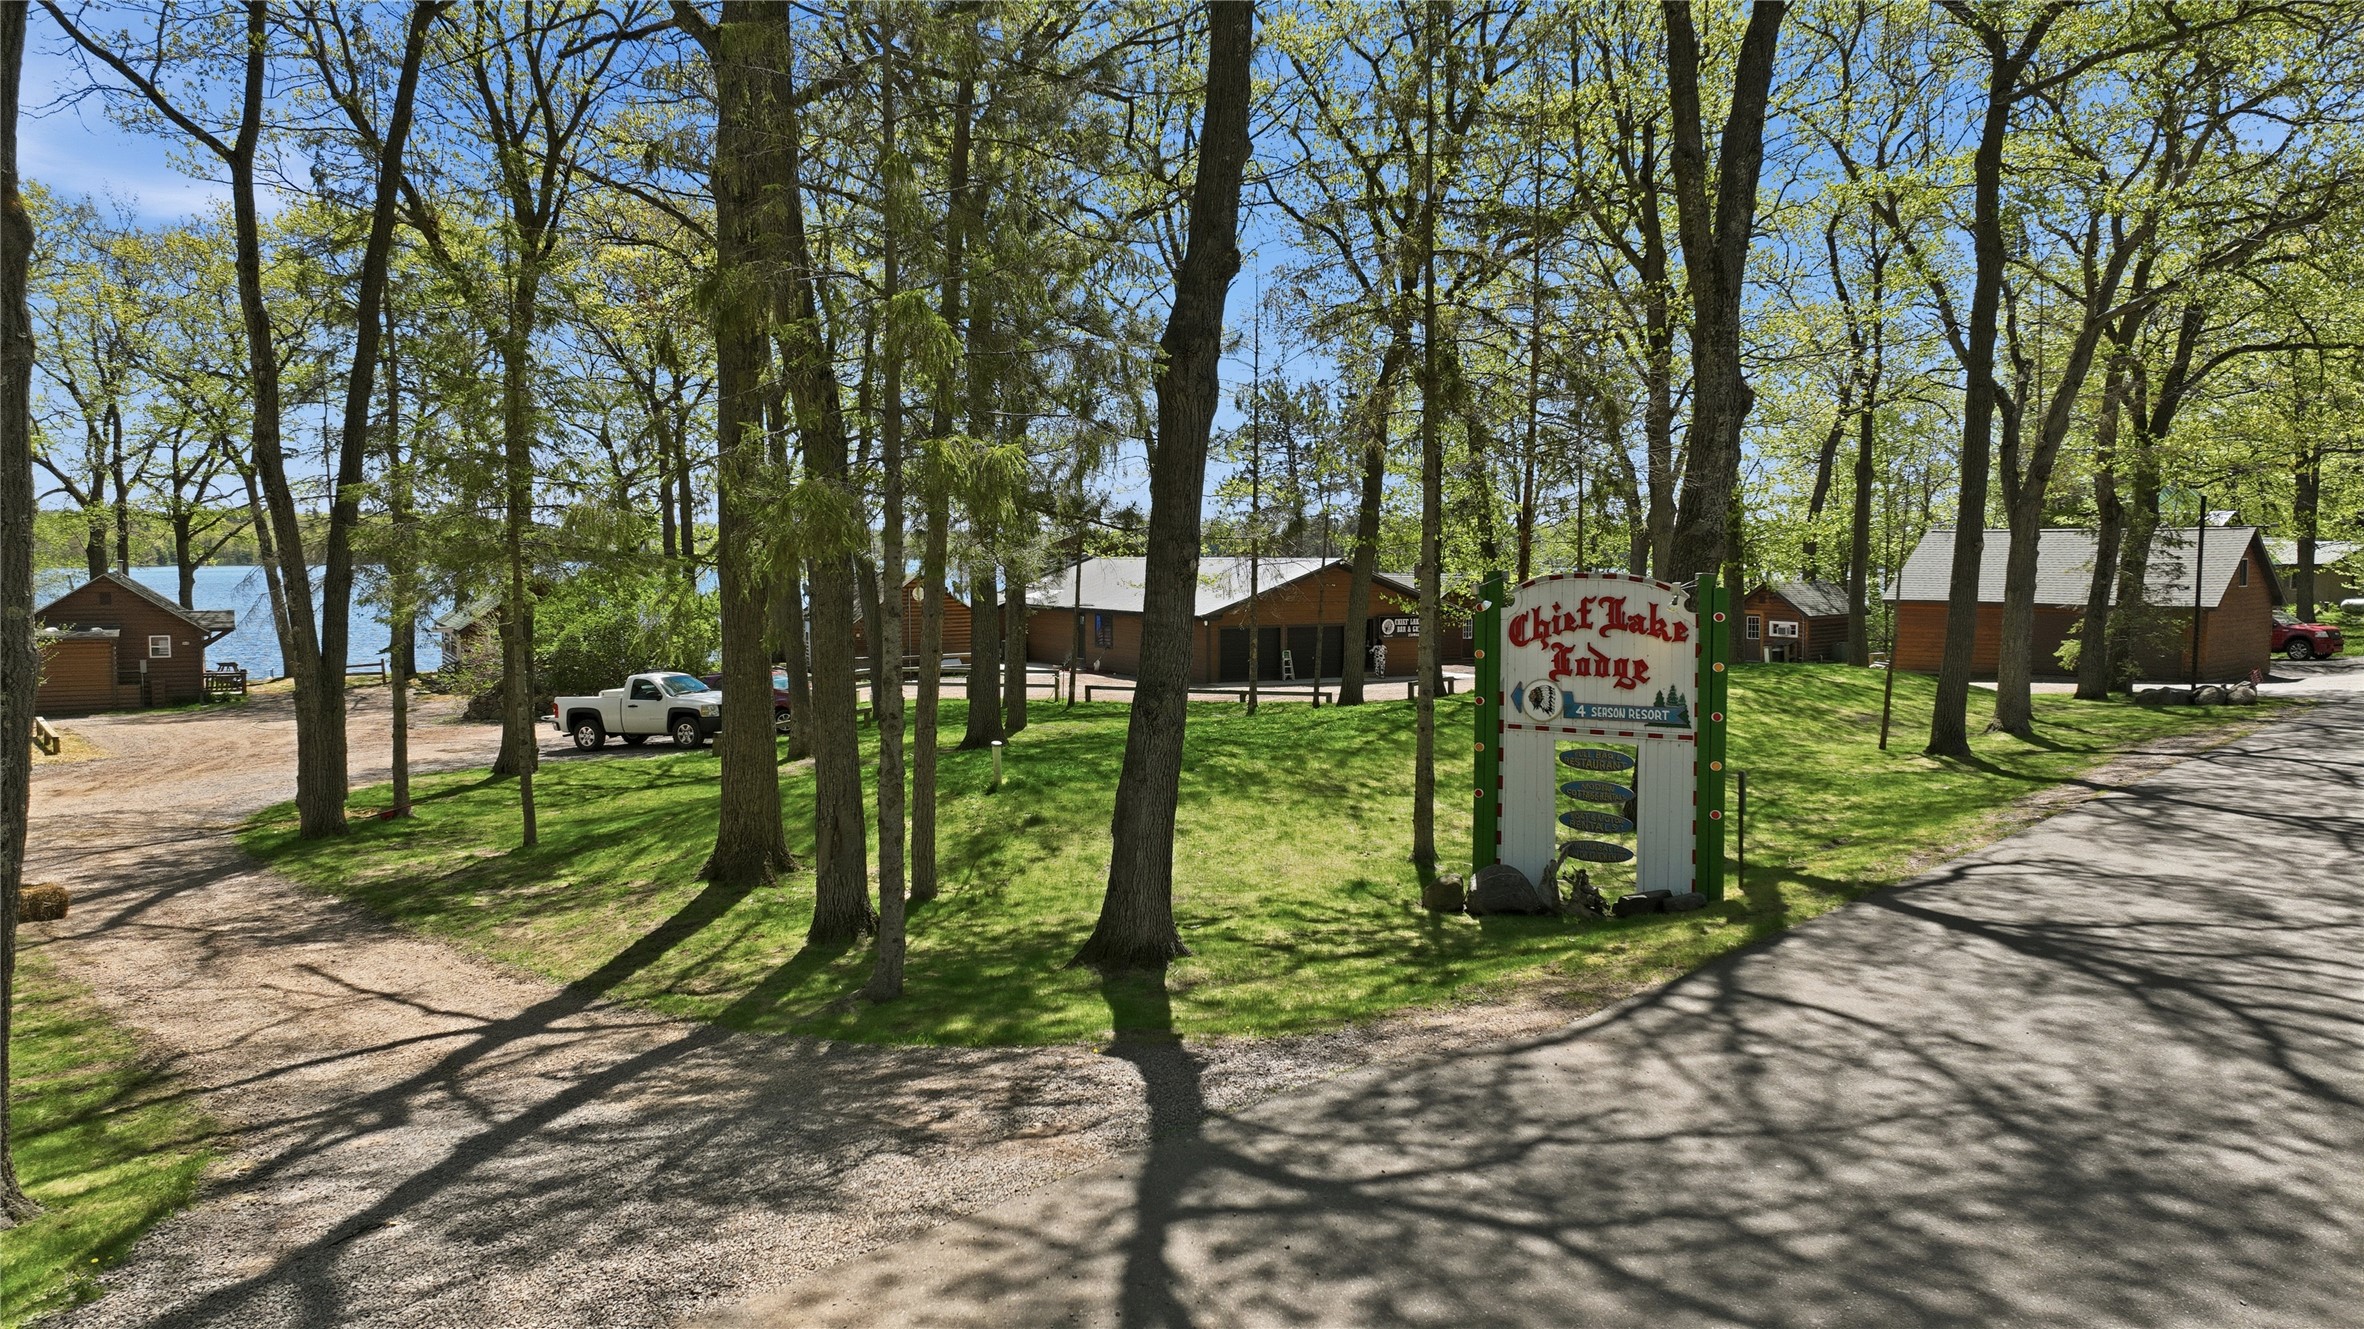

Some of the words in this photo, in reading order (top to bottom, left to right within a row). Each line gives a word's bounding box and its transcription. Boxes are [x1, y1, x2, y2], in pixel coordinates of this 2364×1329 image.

[1508, 596, 1597, 650] Chief
[1598, 596, 1689, 643] Lake
[1548, 642, 1650, 690] Lodge
[1575, 705, 1586, 717] 4
[1591, 706, 1626, 719] SEASON
[1628, 708, 1670, 720] RESORT
[1595, 751, 1614, 759] BAR
[1564, 756, 1628, 770] RESTAURANT
[1569, 819, 1619, 832] RENTALS
